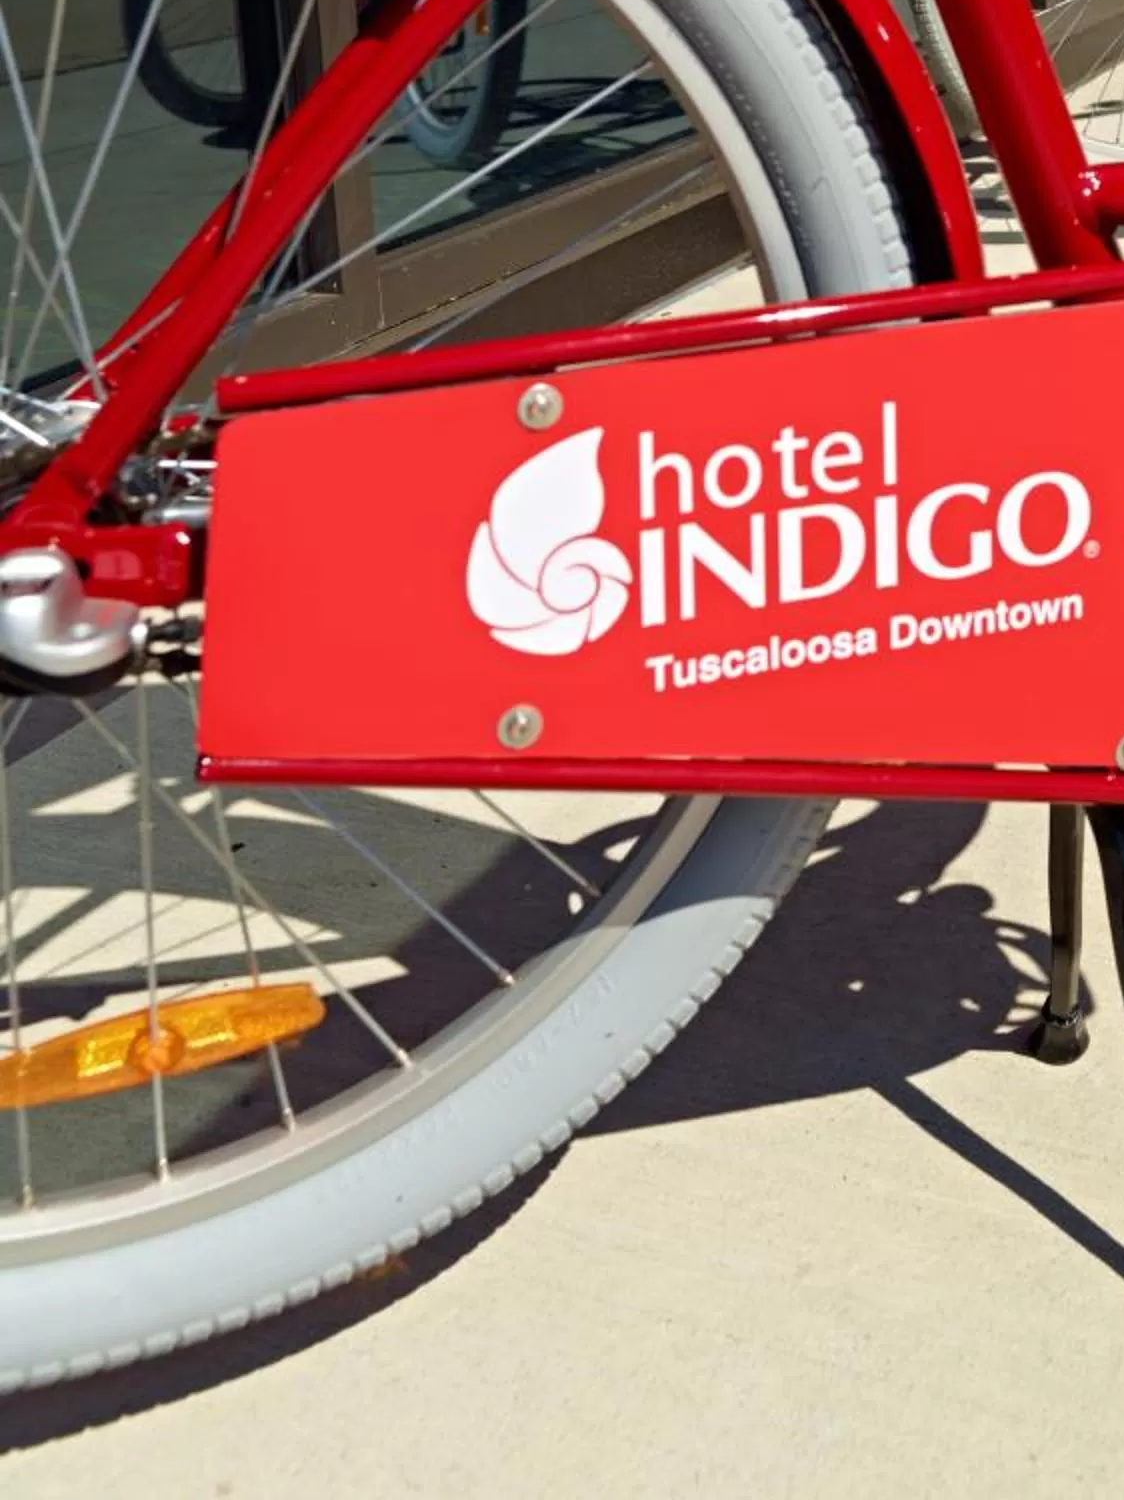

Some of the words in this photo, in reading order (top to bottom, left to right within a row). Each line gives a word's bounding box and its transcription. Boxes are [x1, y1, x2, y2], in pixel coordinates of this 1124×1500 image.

[638, 401, 897, 521] hotel
[638, 470, 1091, 628] INDIGO
[645, 627, 877, 693] Tuscaloosa
[889, 593, 1083, 650] Downtown
